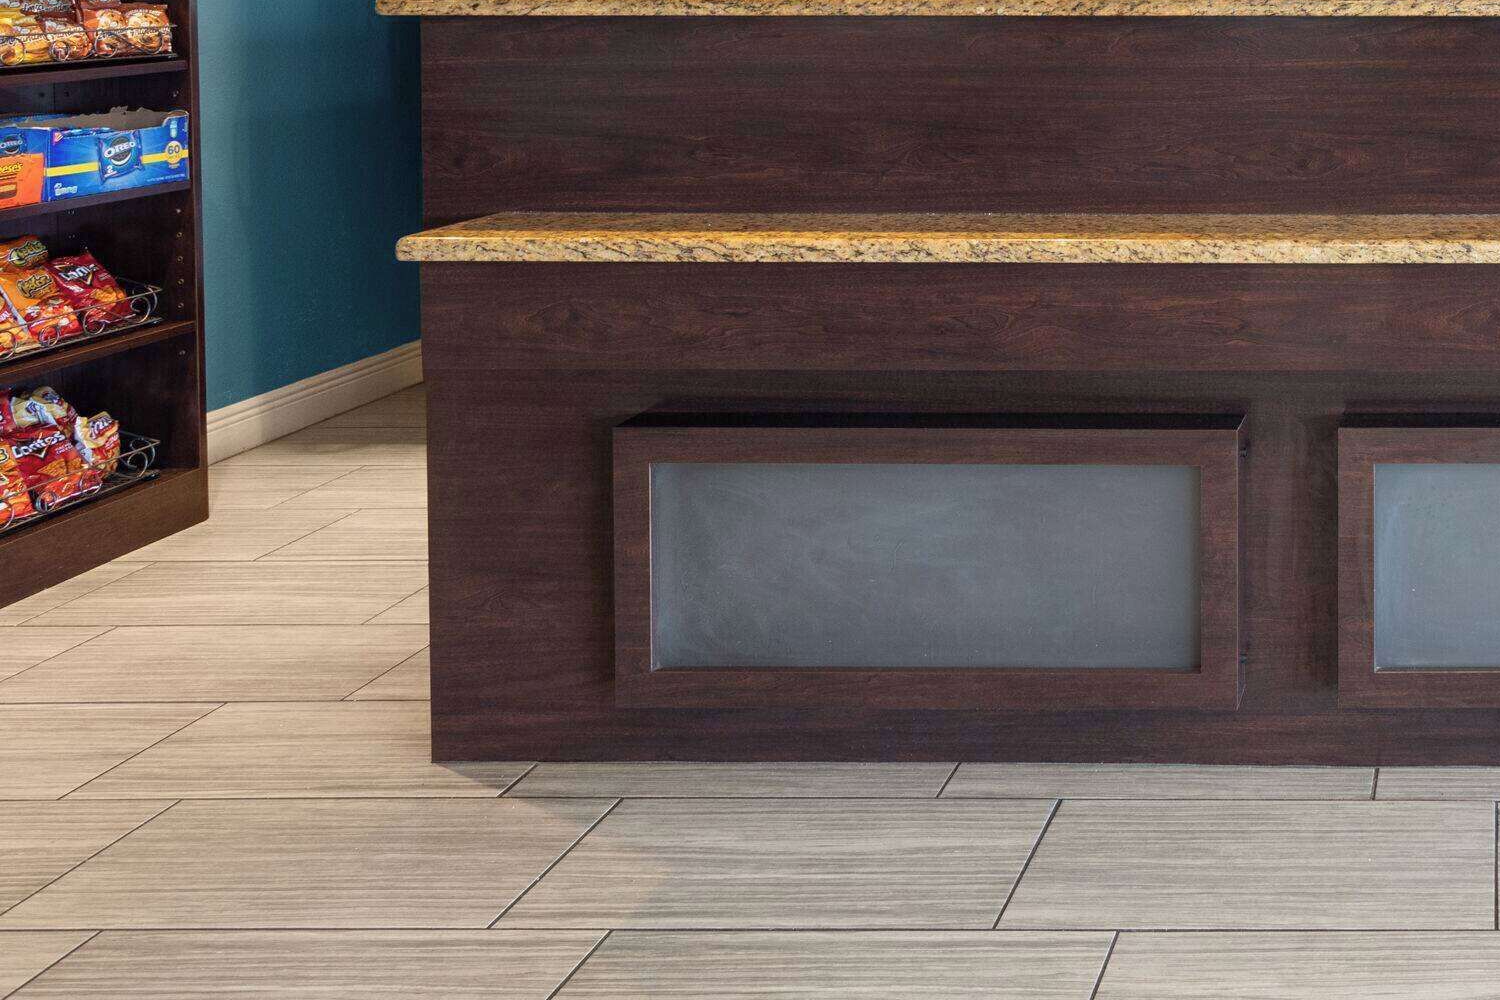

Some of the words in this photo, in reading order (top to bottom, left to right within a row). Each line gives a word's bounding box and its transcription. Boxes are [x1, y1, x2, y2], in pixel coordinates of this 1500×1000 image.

[103, 141, 136, 158] OREO
[168, 145, 180, 154] 60
[12, 430, 66, 459] Doritos
